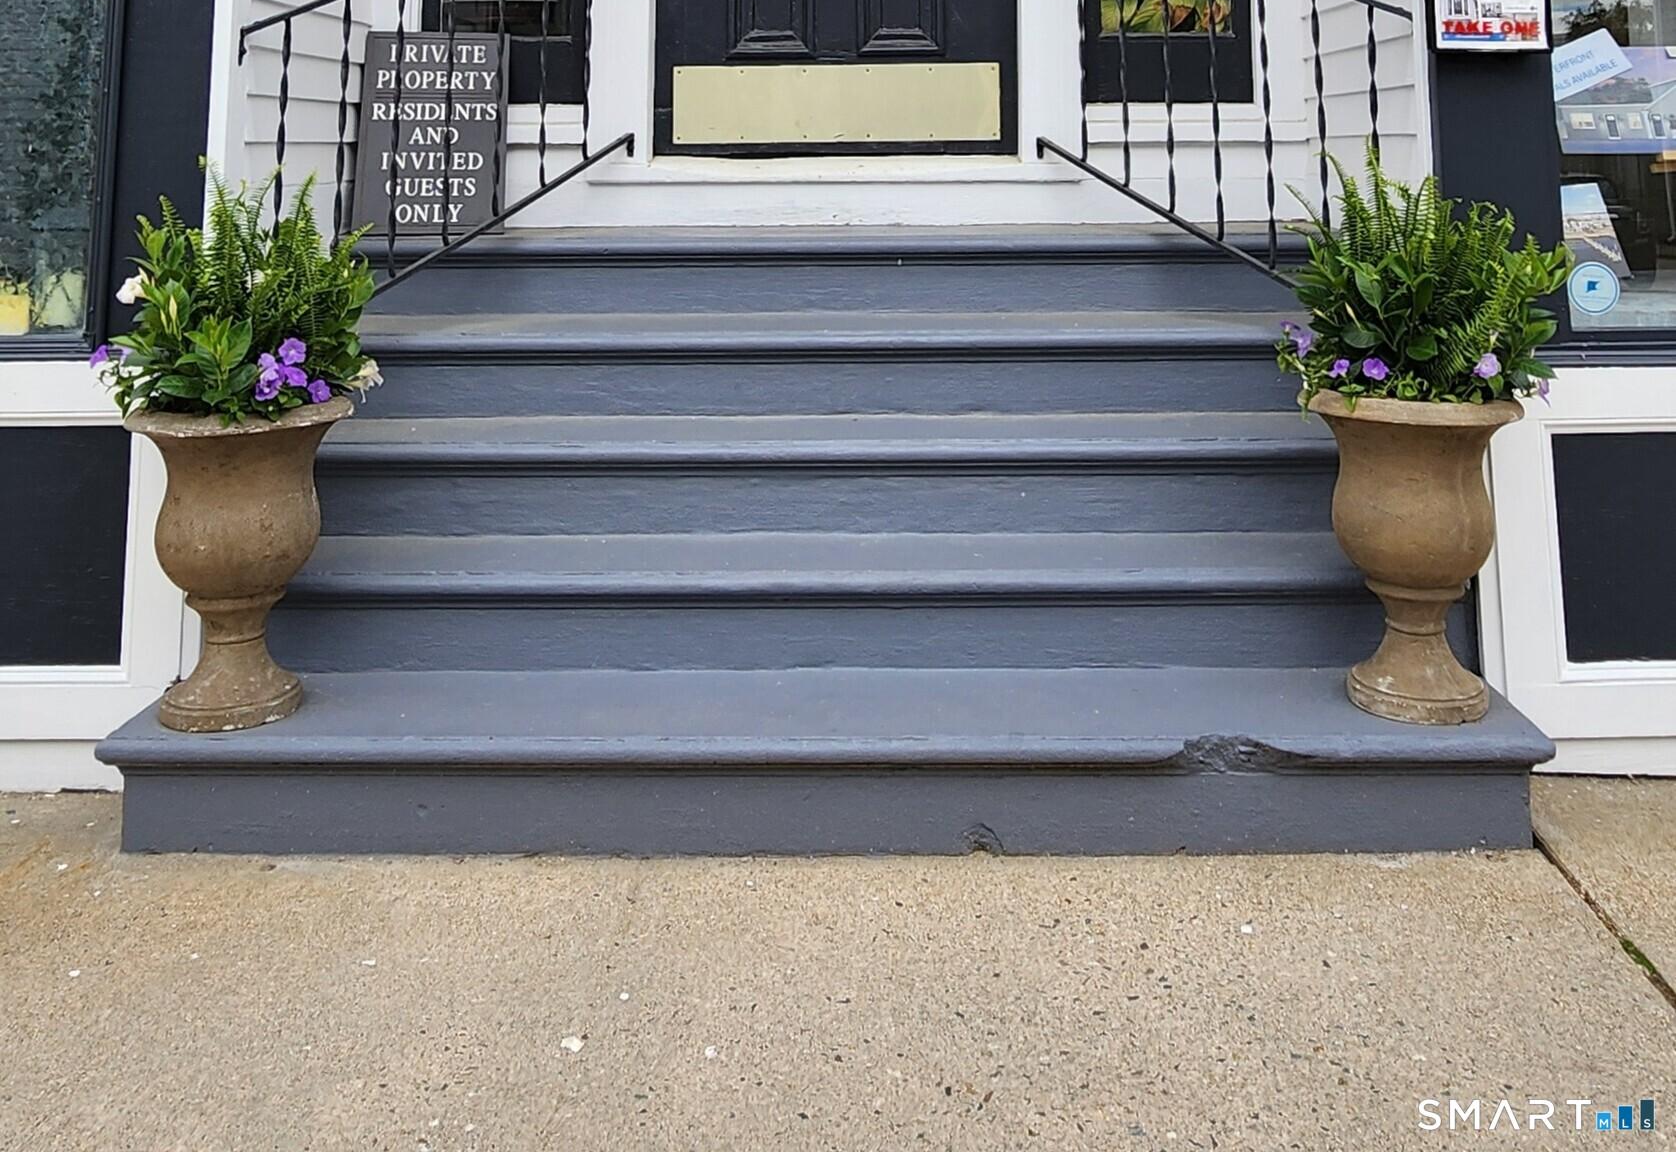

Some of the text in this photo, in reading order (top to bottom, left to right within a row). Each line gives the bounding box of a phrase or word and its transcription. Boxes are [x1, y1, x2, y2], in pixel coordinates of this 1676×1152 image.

[1442, 20, 1540, 36] TAKE ONE
[1571, 58, 1618, 87] AVAILABLE
[408, 126, 460, 145] AND
[380, 152, 484, 170] INVITED
[385, 177, 477, 197] GUESTS
[394, 203, 464, 224] ONLY
